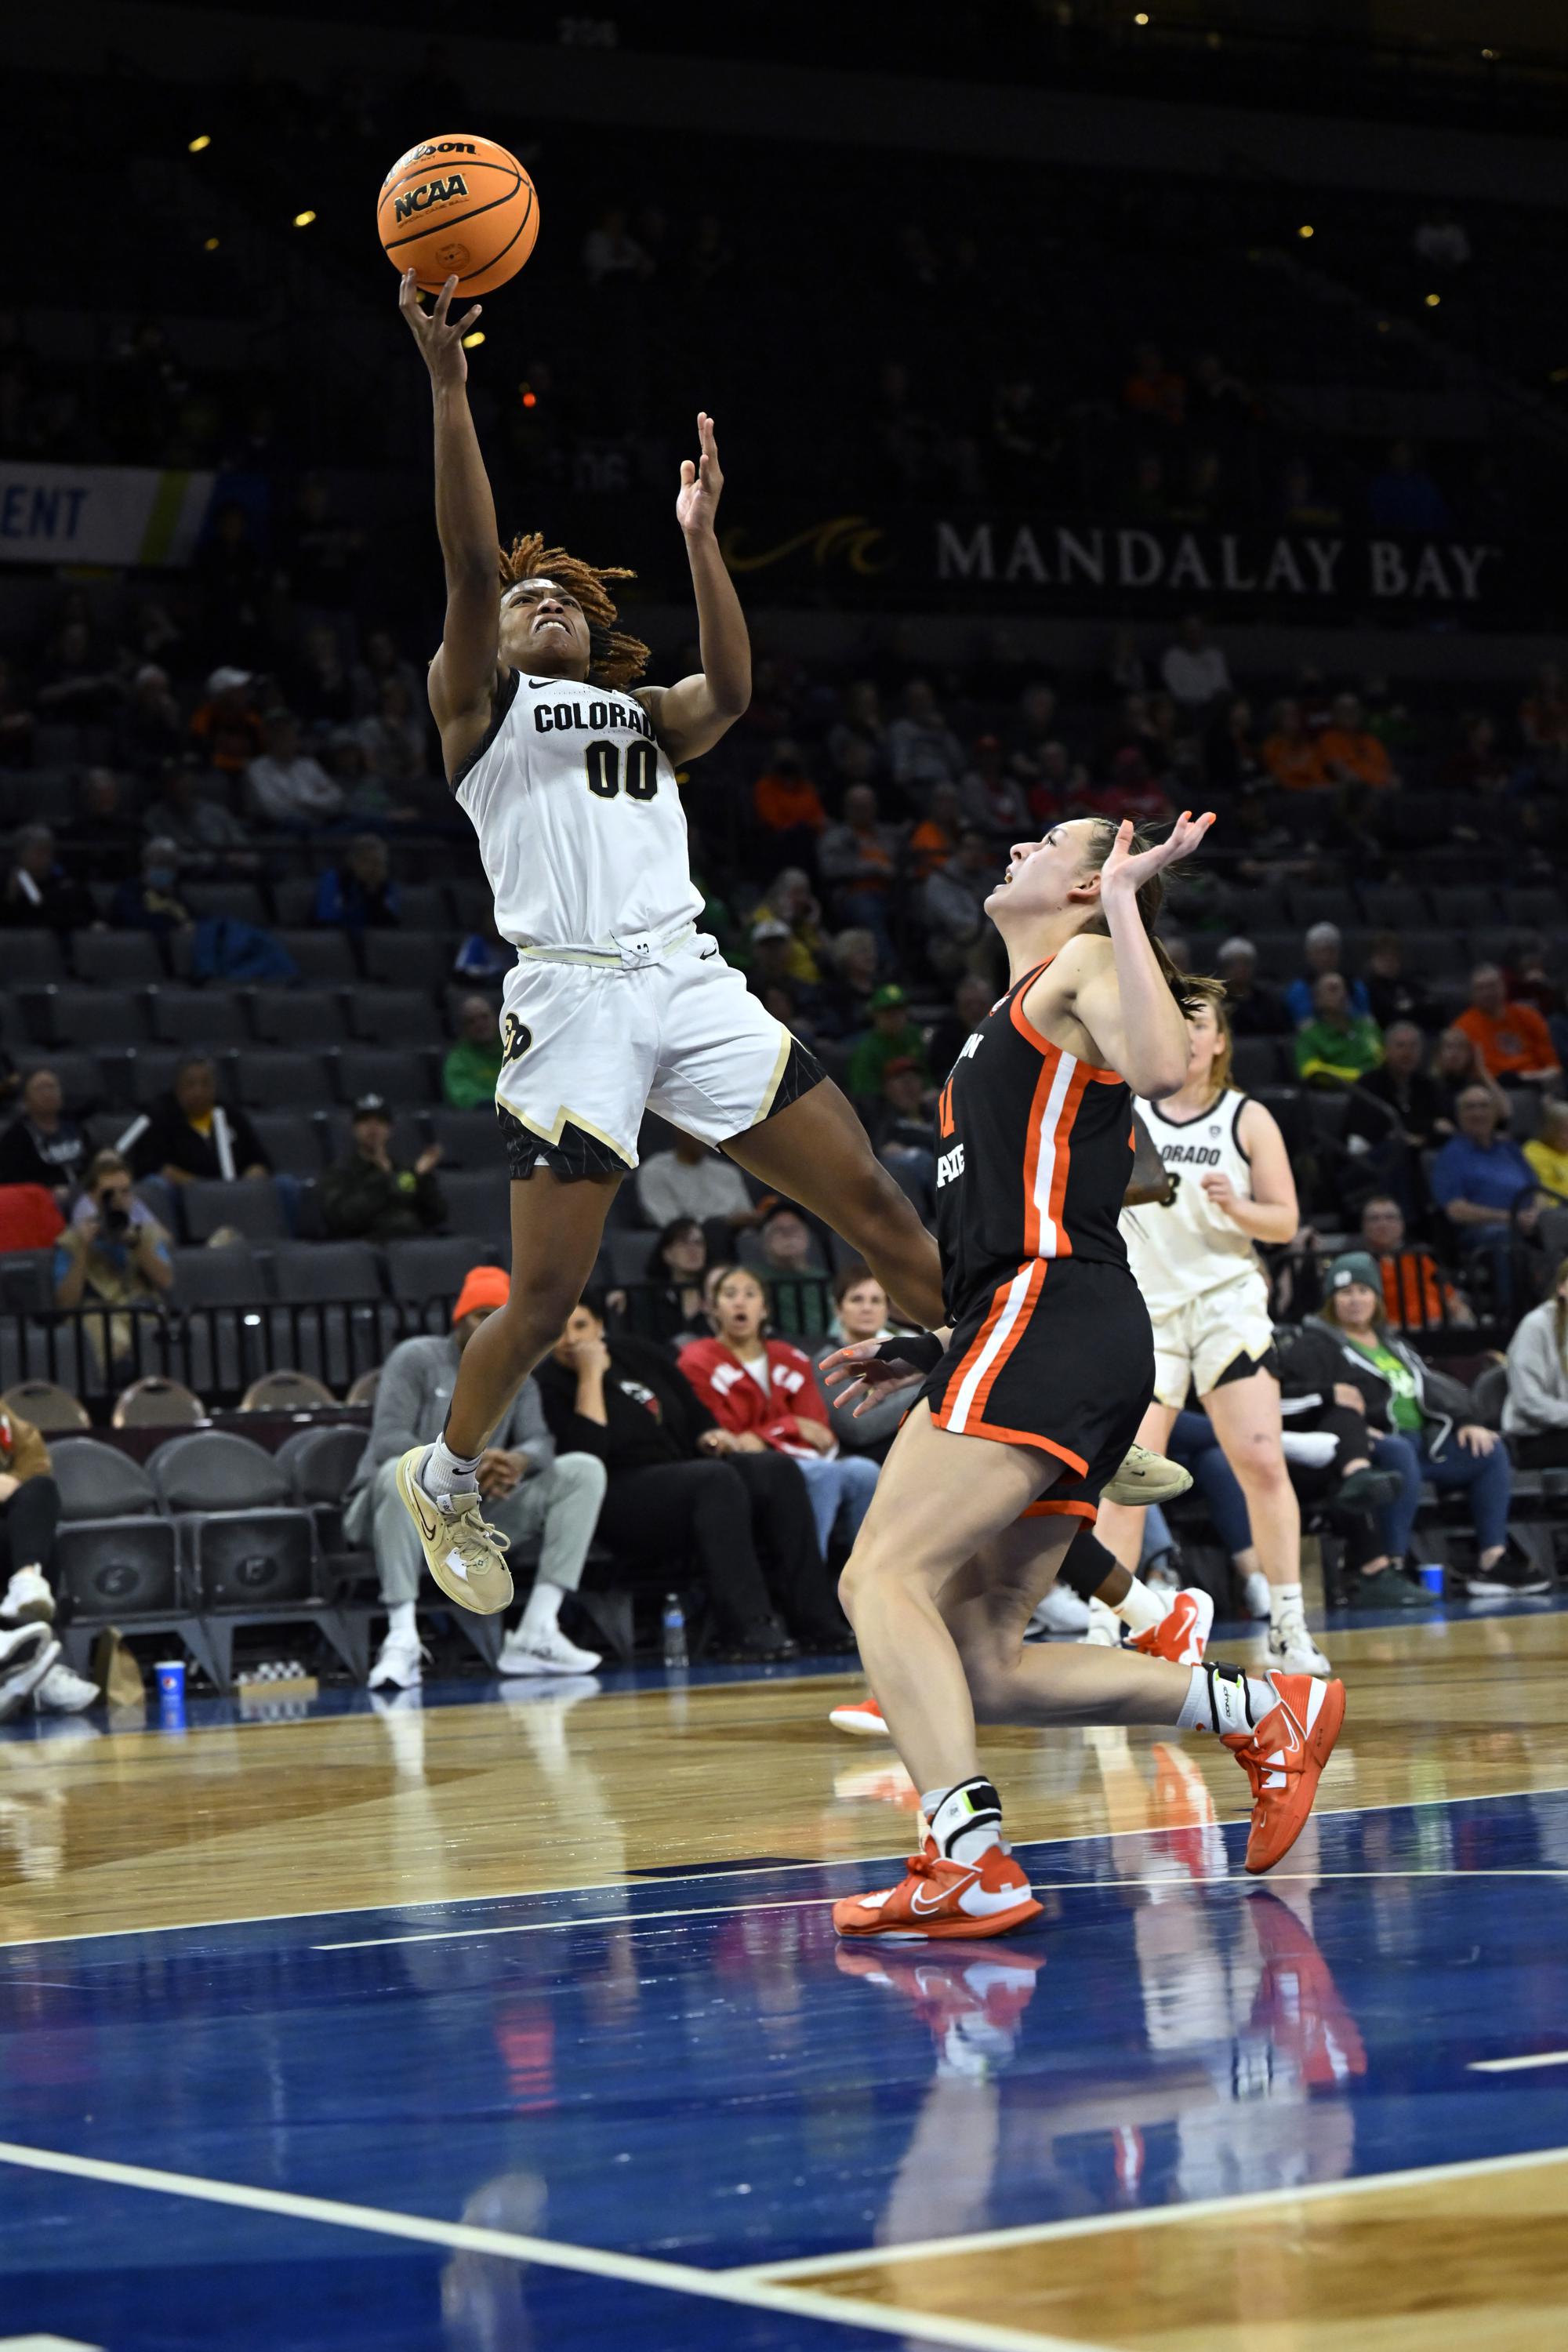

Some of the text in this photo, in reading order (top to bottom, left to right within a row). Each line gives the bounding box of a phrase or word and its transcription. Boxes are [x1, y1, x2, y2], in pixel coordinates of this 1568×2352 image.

[394, 173, 469, 223] NCAA
[933, 521, 1489, 601] MANDALAY BAY
[584, 739, 659, 802] 00
